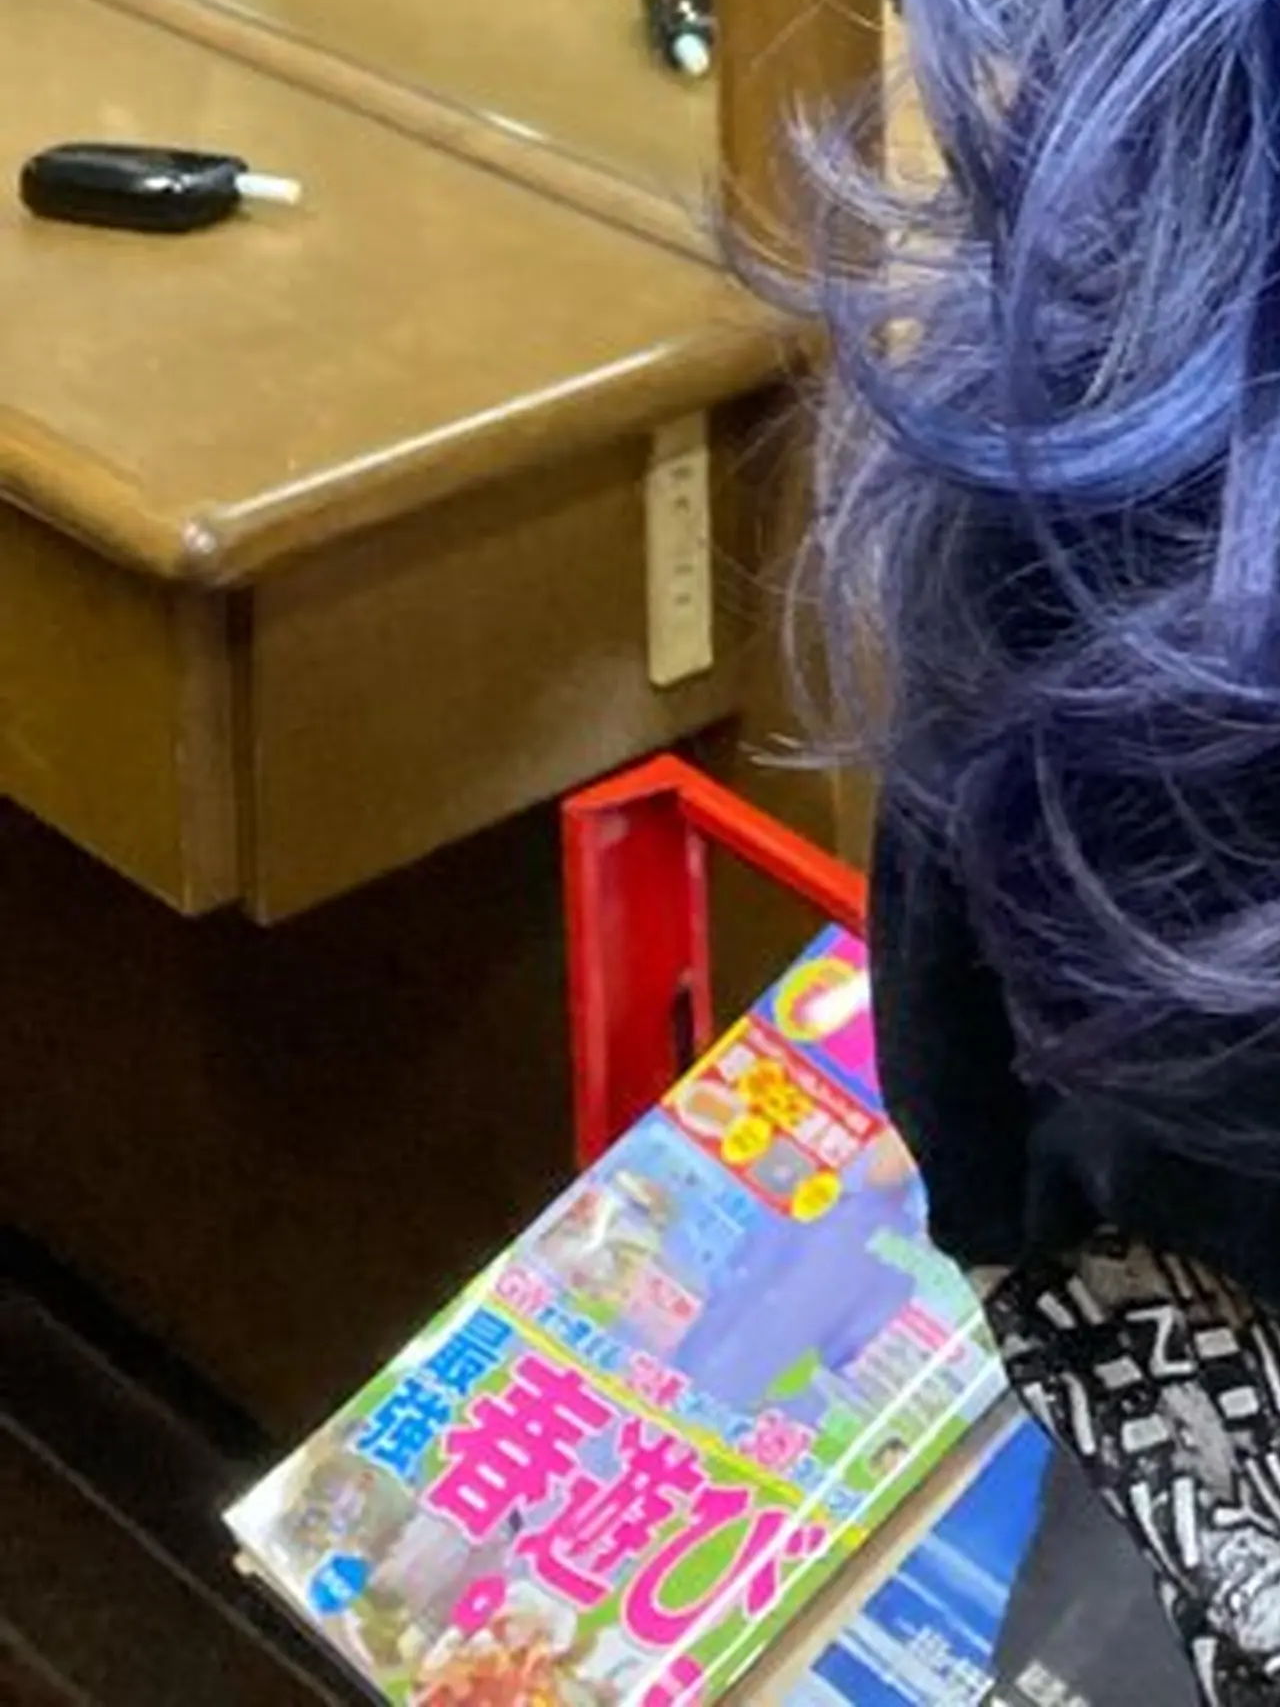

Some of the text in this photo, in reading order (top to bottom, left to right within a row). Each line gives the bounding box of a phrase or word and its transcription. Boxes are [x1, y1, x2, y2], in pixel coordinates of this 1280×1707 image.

[352, 1305, 516, 1481] 最強
[422, 1353, 828, 1647] 春遊び
